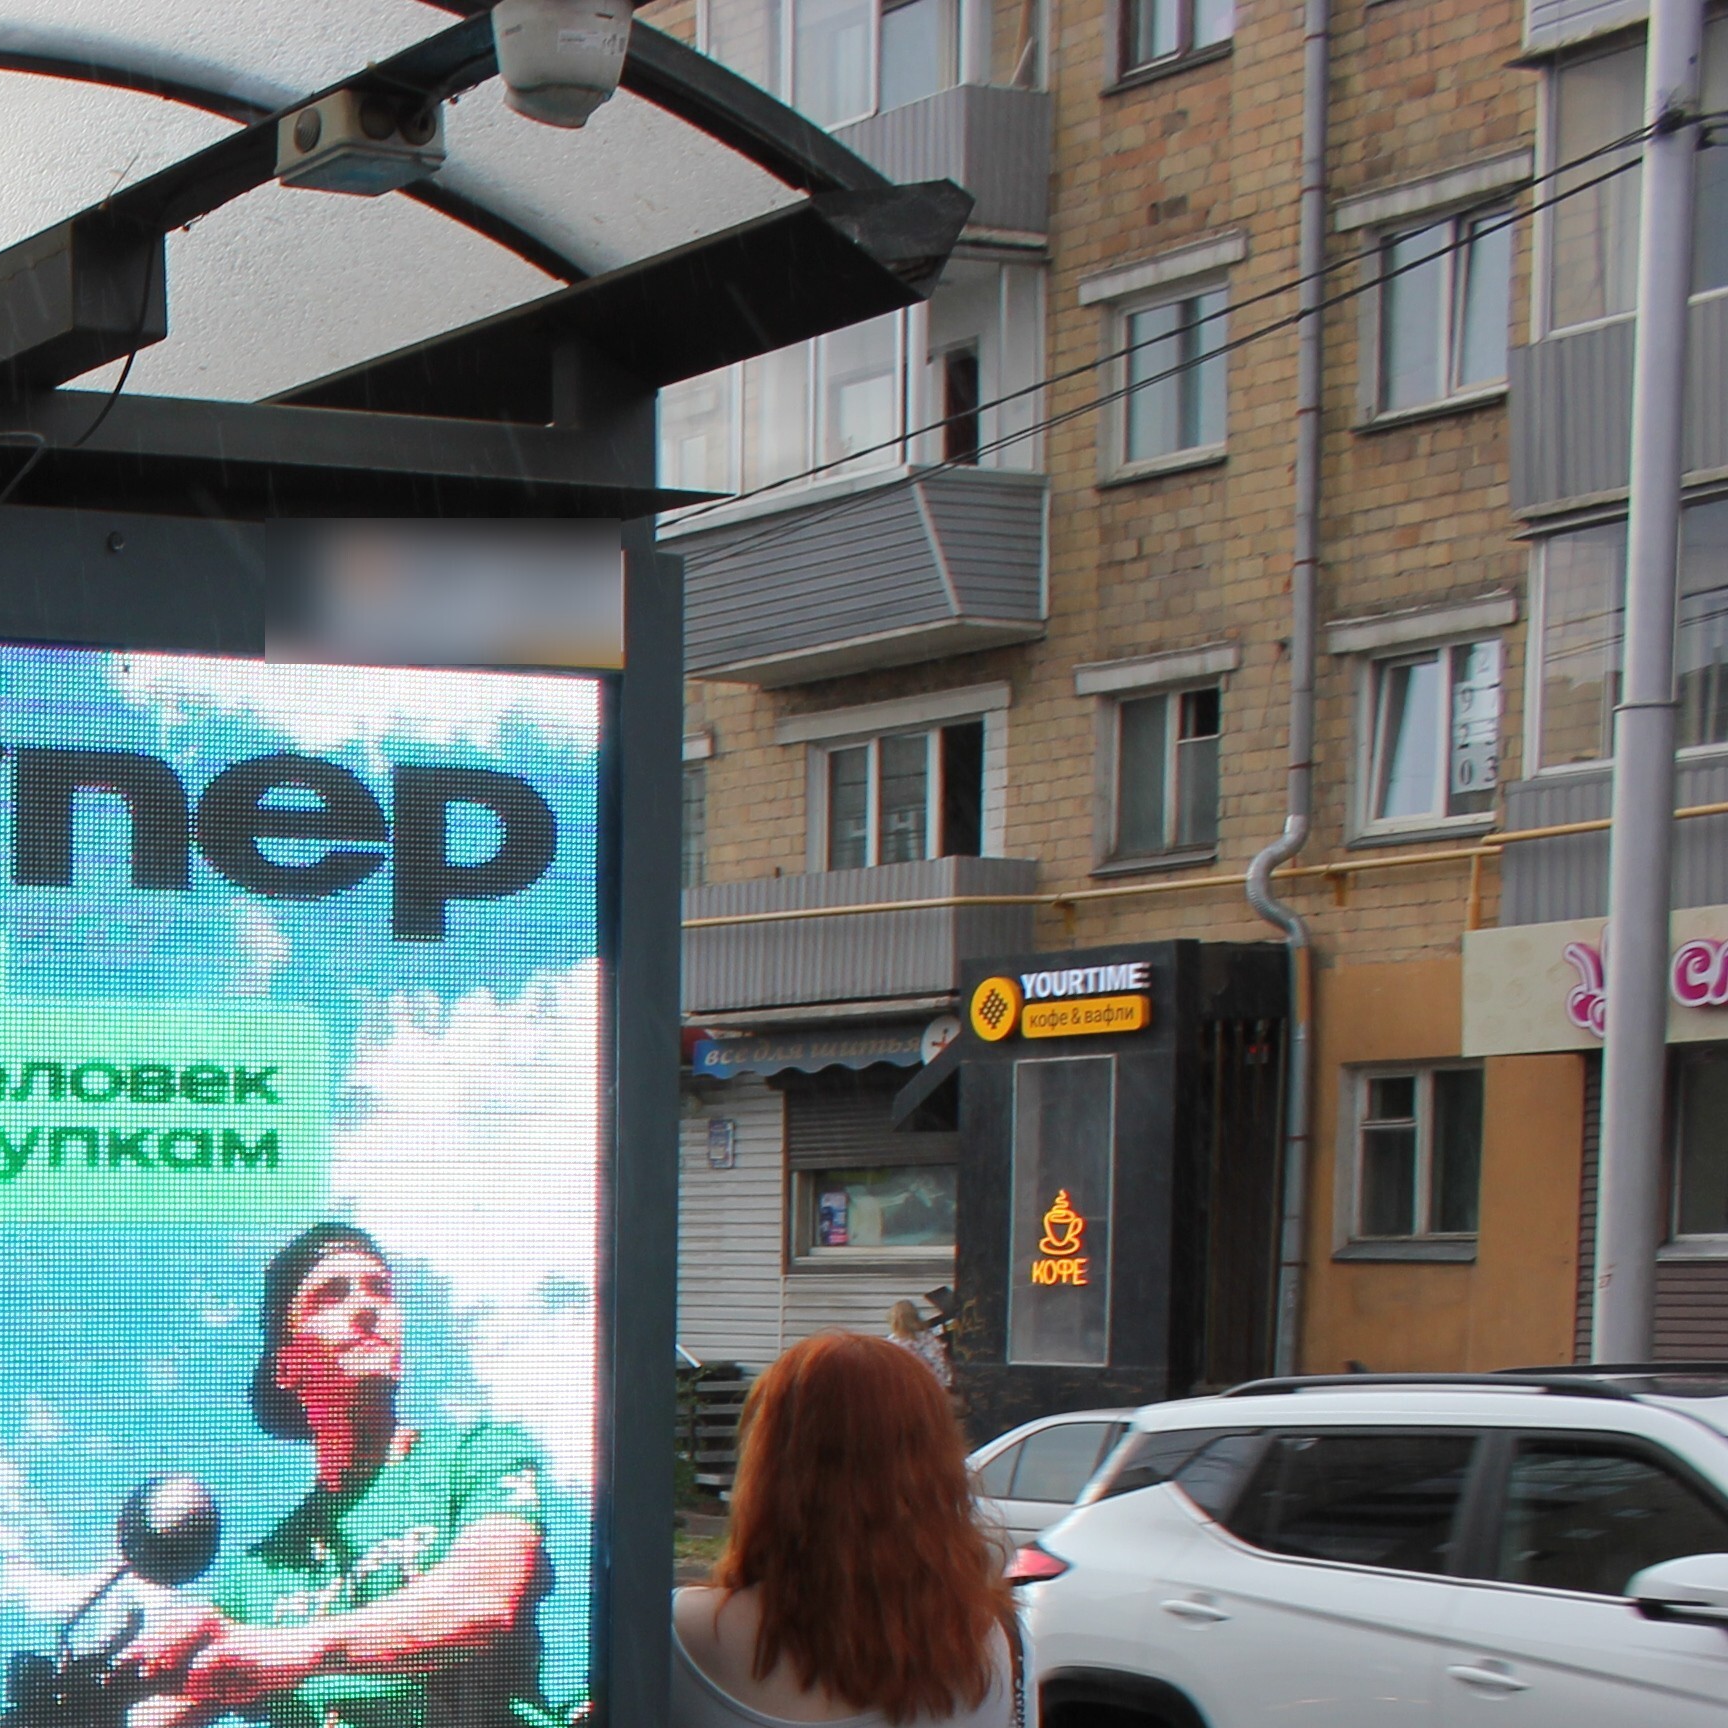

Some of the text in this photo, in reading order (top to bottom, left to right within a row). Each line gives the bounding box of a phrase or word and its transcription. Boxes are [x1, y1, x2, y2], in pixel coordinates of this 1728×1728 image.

[1020, 961, 1150, 999] YOURTIME
[1029, 1004, 1135, 1030] кофе & вафли
[753, 1040, 804, 1063] для
[809, 1036, 921, 1059] шитья
[1032, 1258, 1089, 1285] КОФЕ
